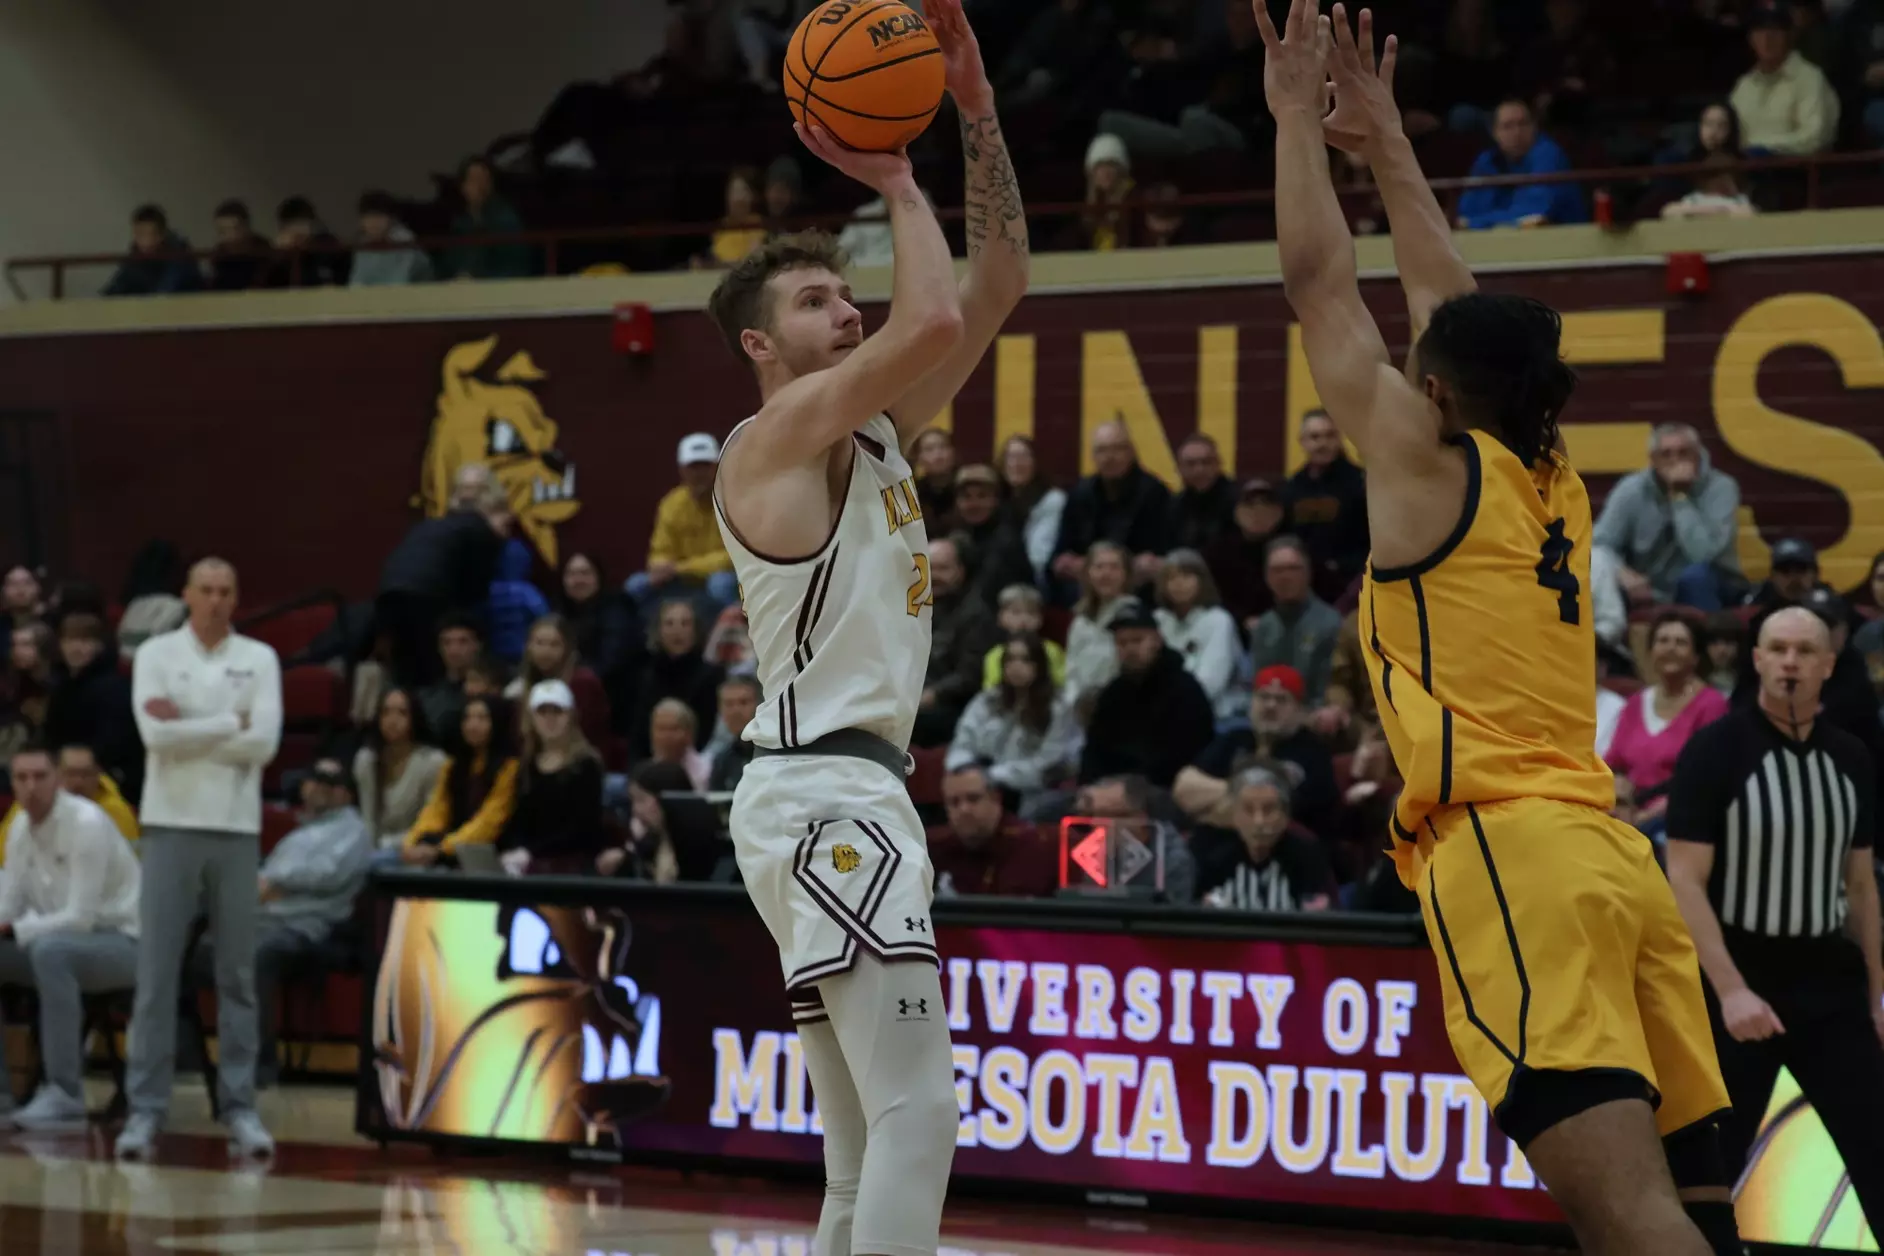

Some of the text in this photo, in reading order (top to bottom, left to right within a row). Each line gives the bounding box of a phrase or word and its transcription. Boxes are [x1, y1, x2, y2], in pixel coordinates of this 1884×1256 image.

[867, 13, 928, 48] NCAA
[907, 553, 934, 617] 2
[1534, 516, 1580, 627] 4
[938, 957, 1418, 1059] IVERSITY OF
[709, 1027, 1192, 1163] MIESOTA
